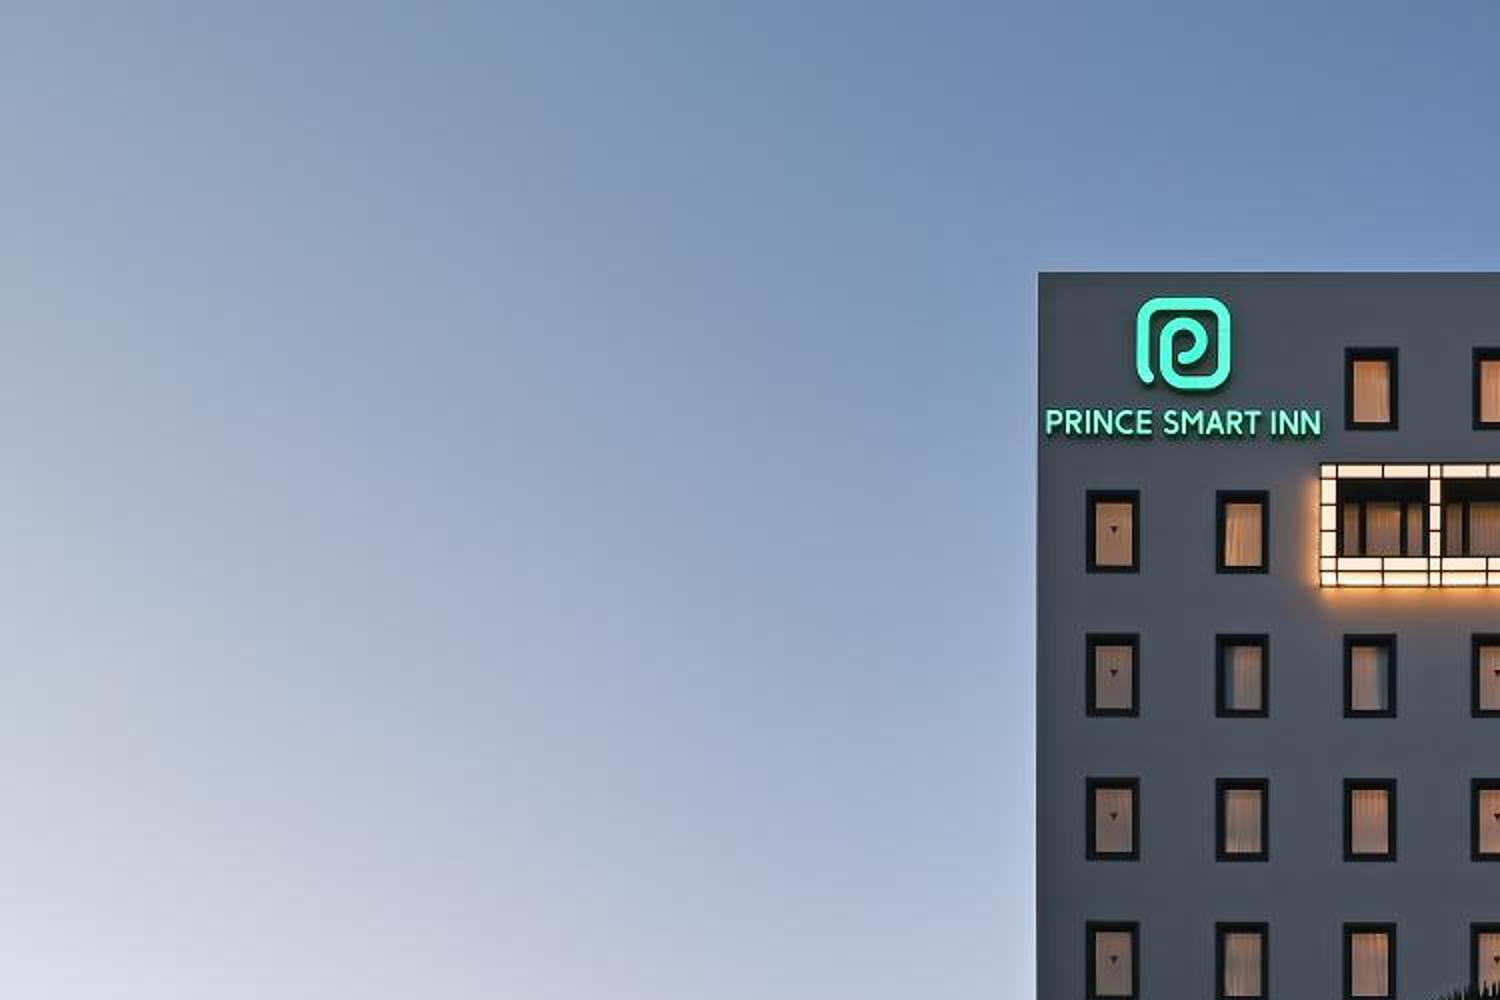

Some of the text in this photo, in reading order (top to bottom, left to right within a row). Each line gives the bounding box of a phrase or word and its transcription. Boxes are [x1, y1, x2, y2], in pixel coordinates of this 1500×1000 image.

[1046, 410, 1321, 435] PRINCE SMART INN
